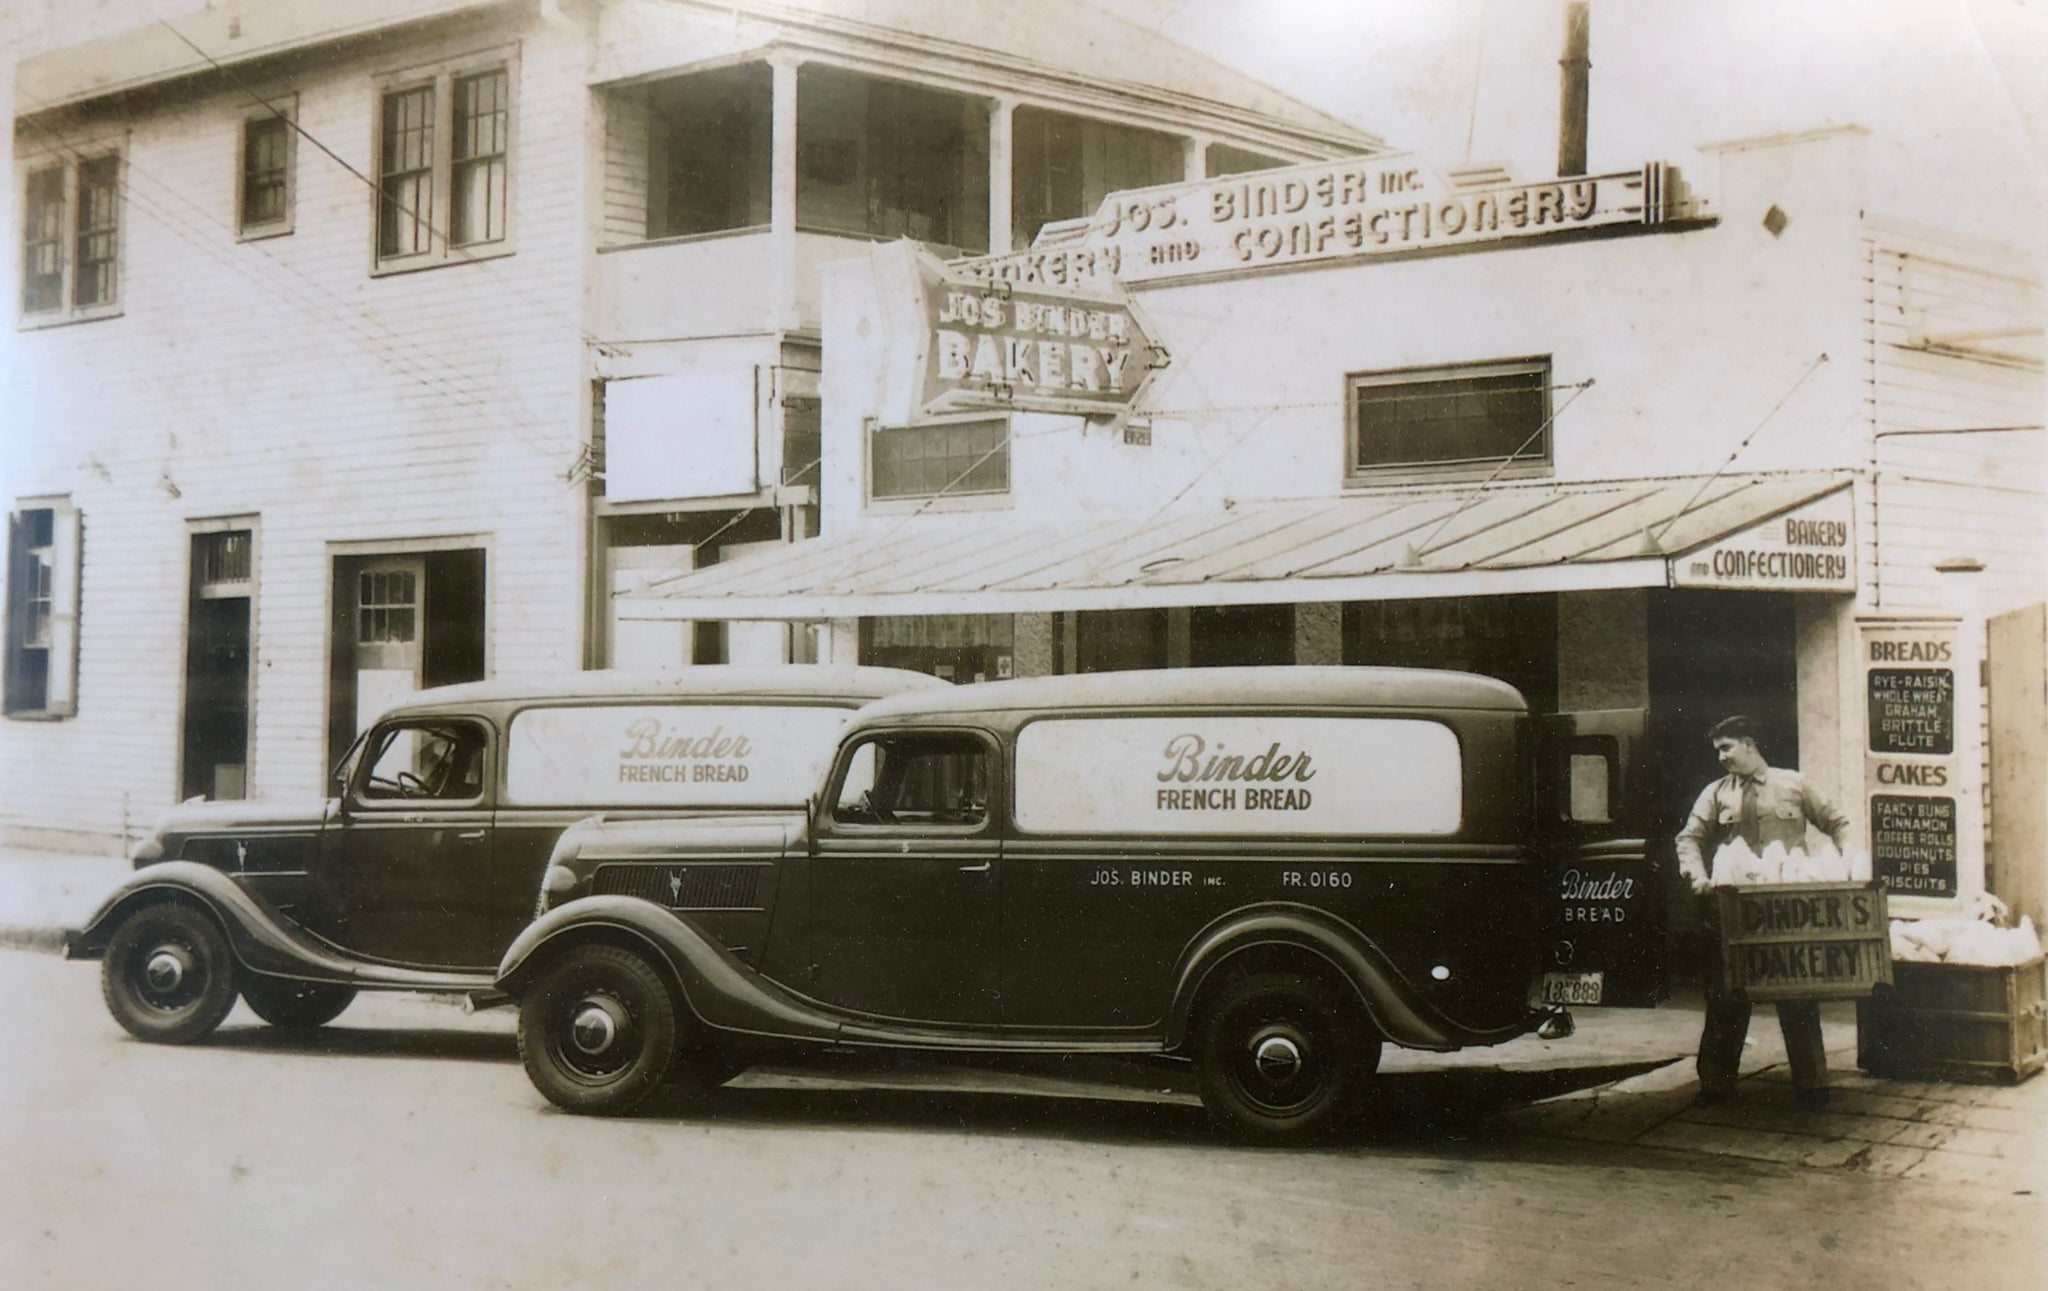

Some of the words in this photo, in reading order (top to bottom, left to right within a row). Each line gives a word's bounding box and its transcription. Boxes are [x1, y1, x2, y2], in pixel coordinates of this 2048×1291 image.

[1104, 196, 1188, 238] JOS.
[1212, 169, 1366, 222] BINDER
[1233, 181, 1598, 261] CONFECTIONERY
[1014, 301, 1130, 344] BINDER
[936, 328, 1131, 394] BAKERY
[1785, 518, 1847, 547] BAKERY
[1713, 549, 1847, 580] CONFECTIONERY
[1870, 641, 1952, 662] BREADS
[1873, 690, 1910, 703] WHOLE
[1913, 690, 1947, 704] WHEAT
[1885, 704, 1937, 718] GRAHAM
[1882, 719, 1942, 733] BRITTLE
[619, 717, 752, 760] Binder
[1889, 734, 1935, 747] FLUTE
[1157, 733, 1317, 783] Binder
[619, 764, 686, 783] FRENCH
[692, 764, 749, 783] BREAD
[1876, 763, 1948, 787] CAKES
[1157, 788, 1237, 811] FRENCH
[1244, 788, 1312, 811] BREAD
[1877, 802, 1914, 817] FANCY
[1918, 804, 1950, 818] BUNS
[1882, 817, 1948, 832] CINNAMON
[1876, 831, 1915, 845] COFFEE
[1920, 832, 1954, 847] ROLLS
[1877, 846, 1954, 861] DOUGHNUTS
[1090, 870, 1125, 886] JOS.
[1131, 870, 1193, 886] BINDER
[1900, 862, 1930, 875] PIES
[1561, 869, 1634, 900] Binder
[1565, 907, 1626, 922] BREAD
